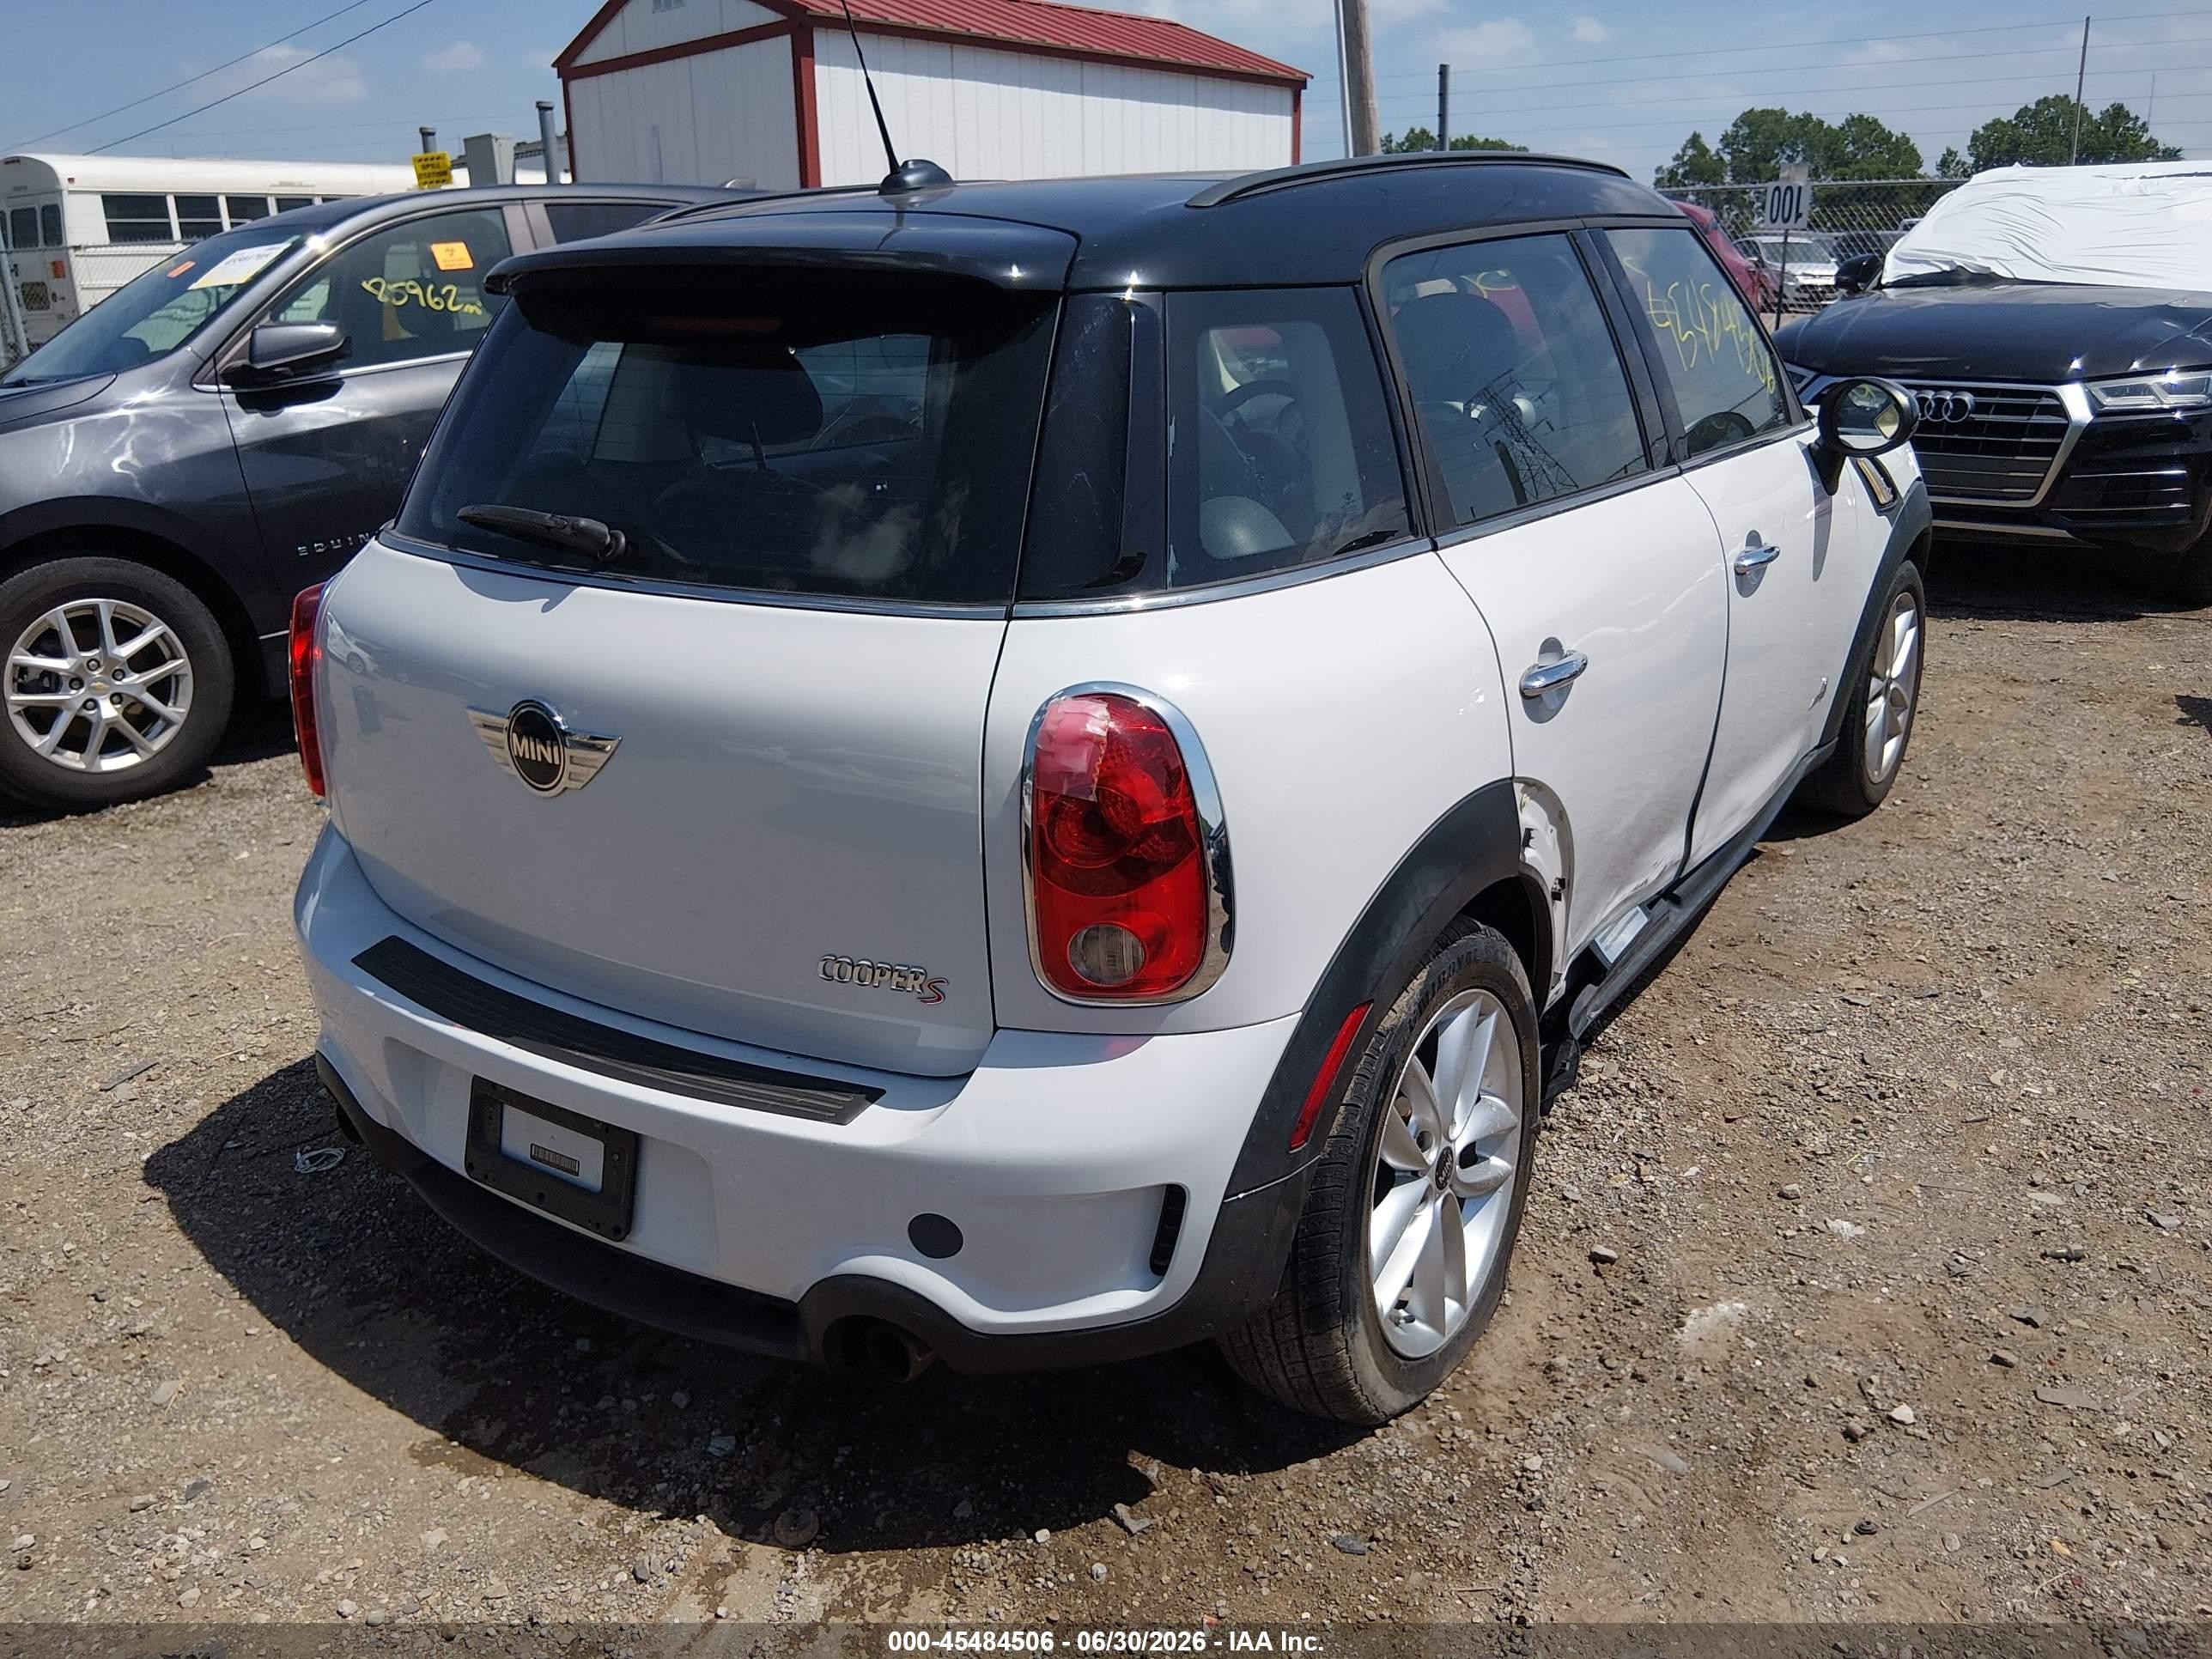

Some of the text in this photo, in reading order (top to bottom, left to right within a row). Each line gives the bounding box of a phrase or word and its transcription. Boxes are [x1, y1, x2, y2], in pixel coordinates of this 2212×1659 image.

[1770, 185, 1802, 223] 100
[512, 732, 561, 766] MINI
[1438, 1153, 1452, 1184] MINI
